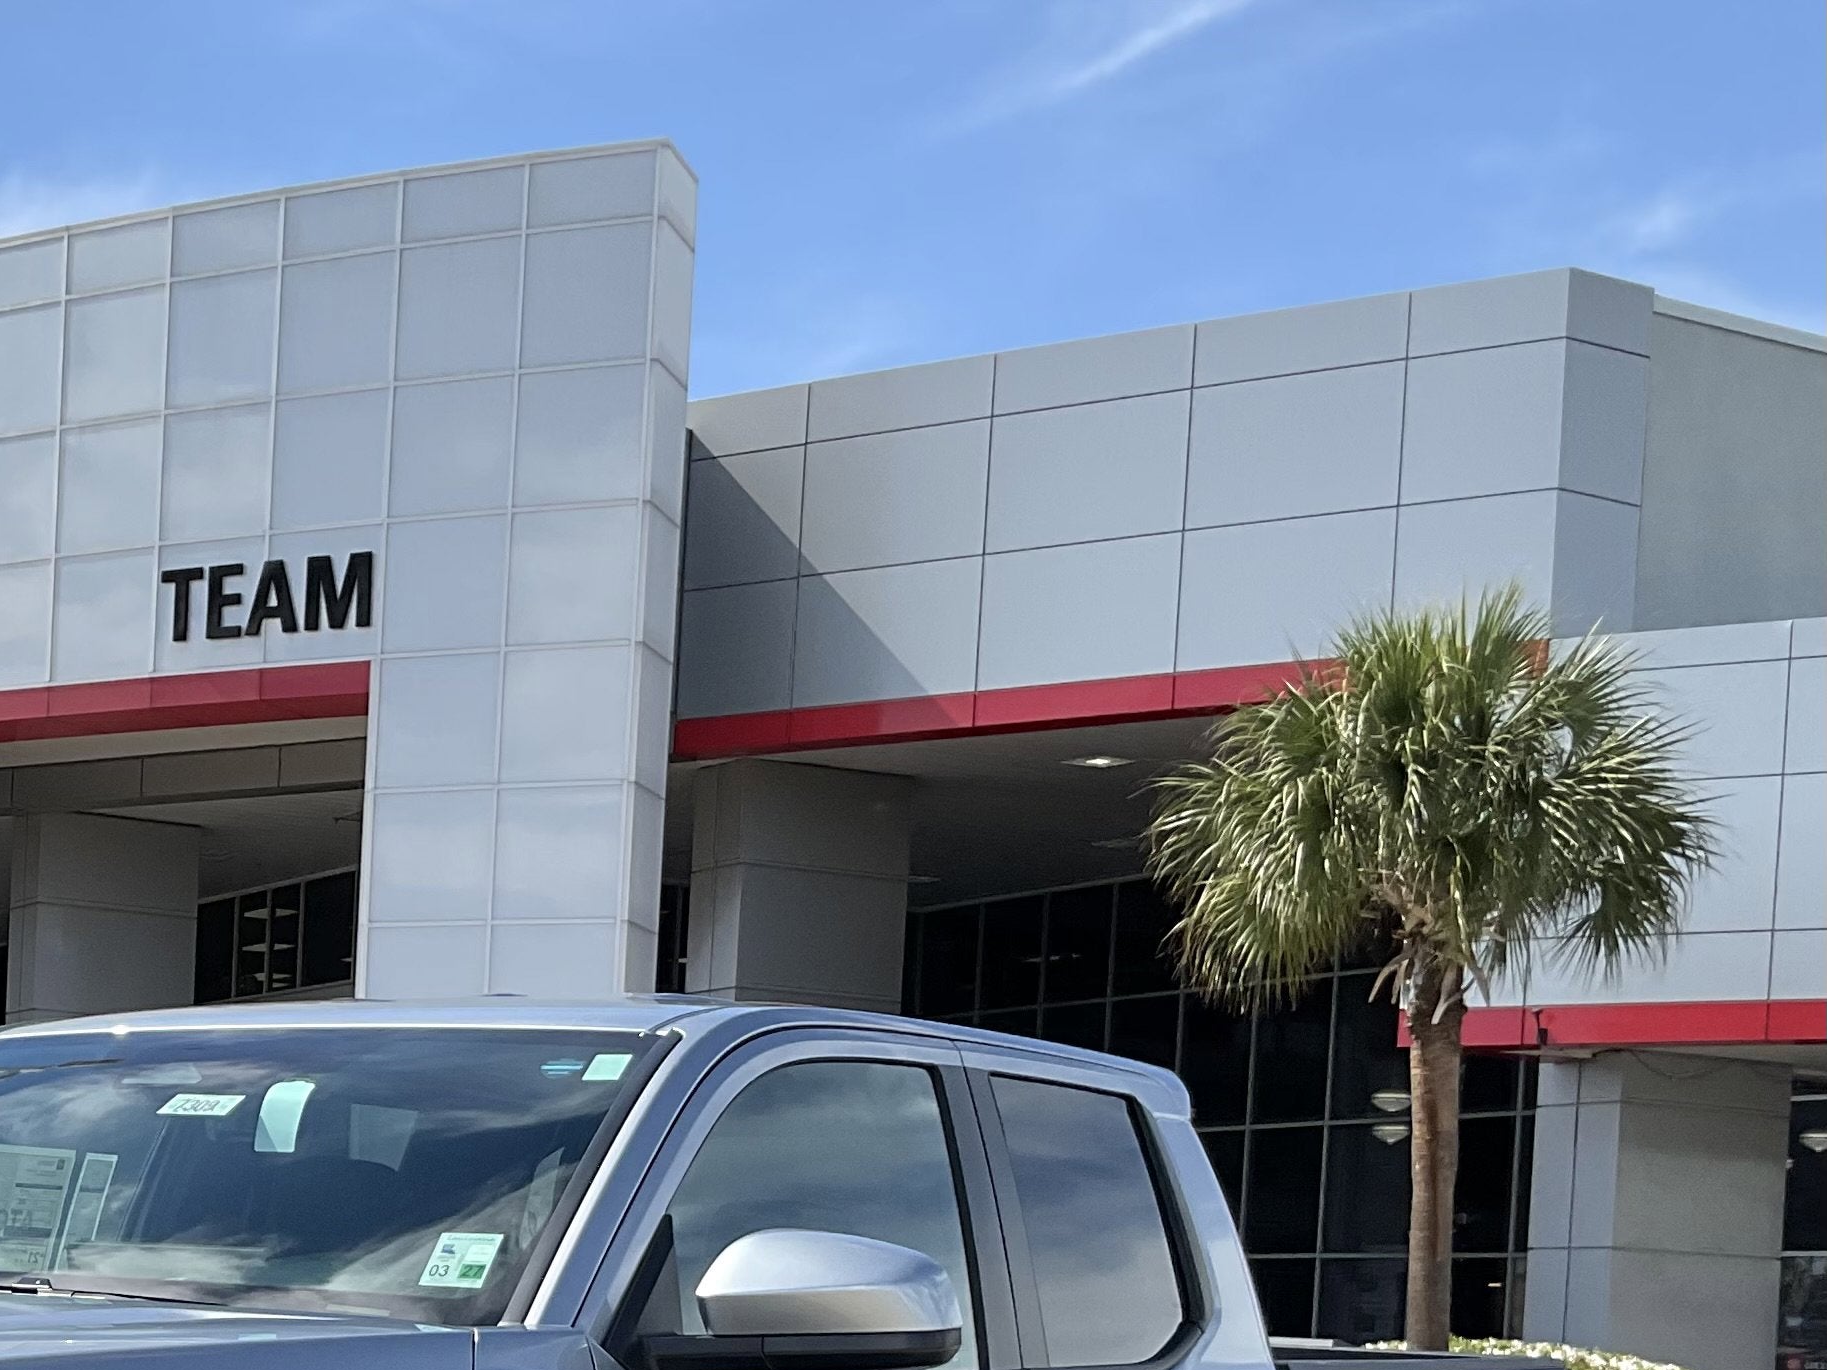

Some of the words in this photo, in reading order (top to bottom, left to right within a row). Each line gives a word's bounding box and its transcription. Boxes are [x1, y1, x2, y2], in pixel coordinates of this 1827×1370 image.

[161, 551, 373, 641] TEAM
[428, 1264, 450, 1277] 03
[459, 1264, 485, 1277] 27
